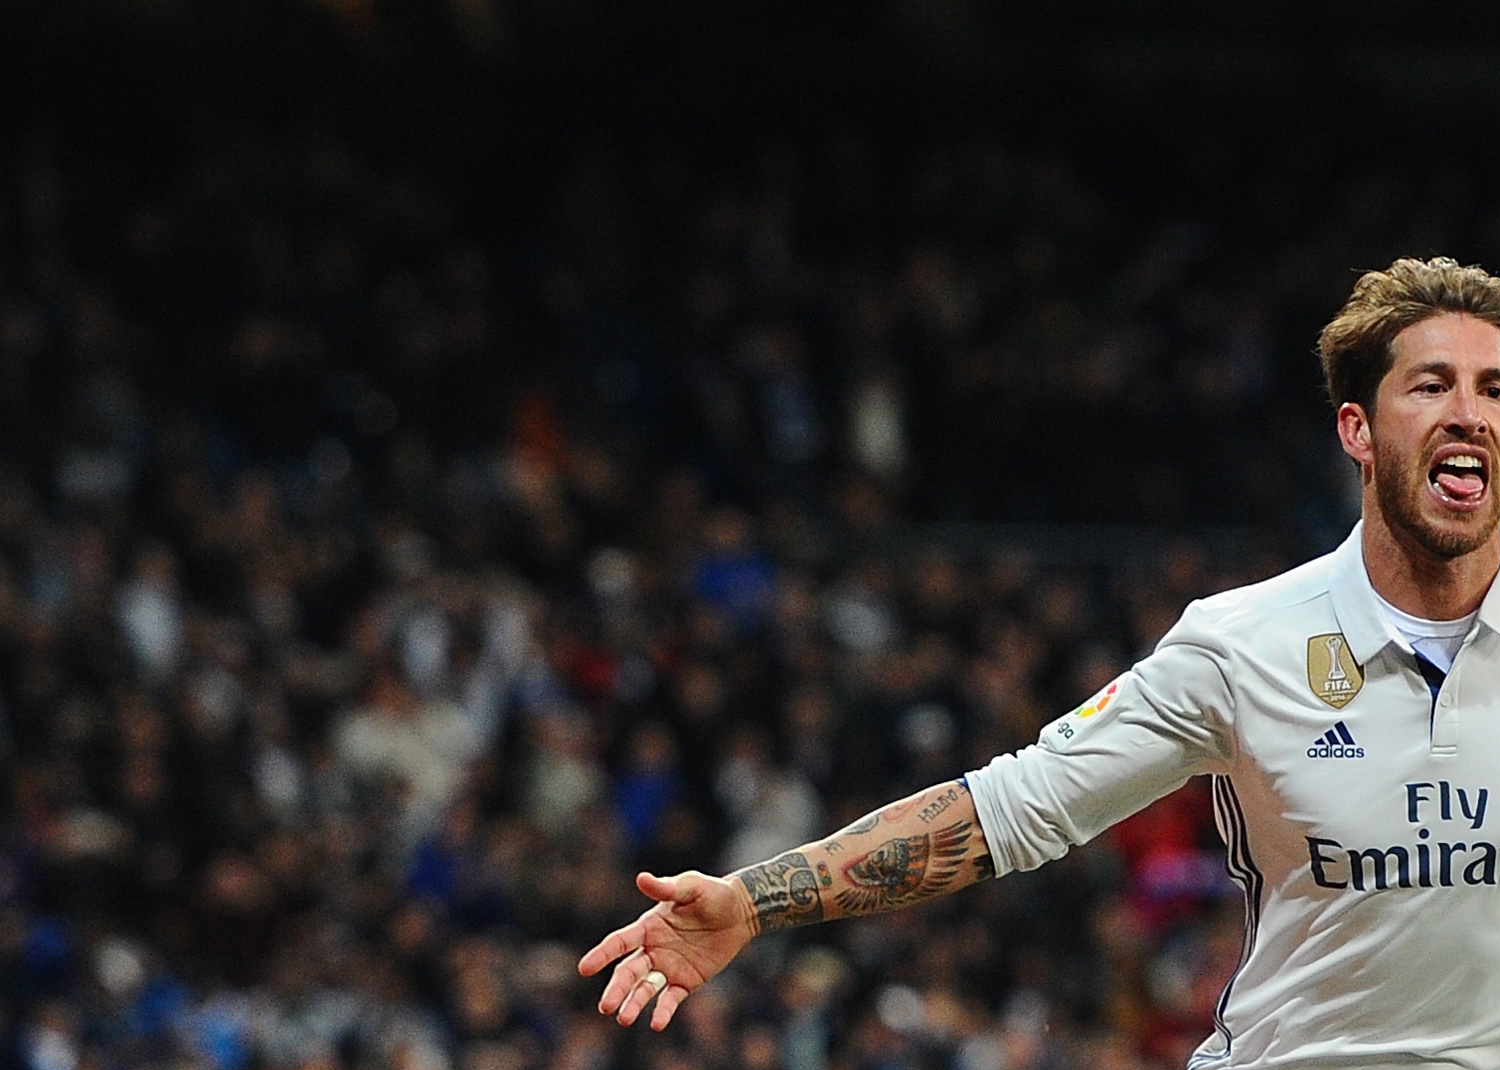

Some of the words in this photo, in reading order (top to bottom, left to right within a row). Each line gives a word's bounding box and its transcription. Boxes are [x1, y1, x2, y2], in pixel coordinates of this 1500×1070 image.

[1324, 680, 1351, 691] FIFA
[1307, 744, 1365, 758] adidas
[1405, 781, 1488, 829] Fly
